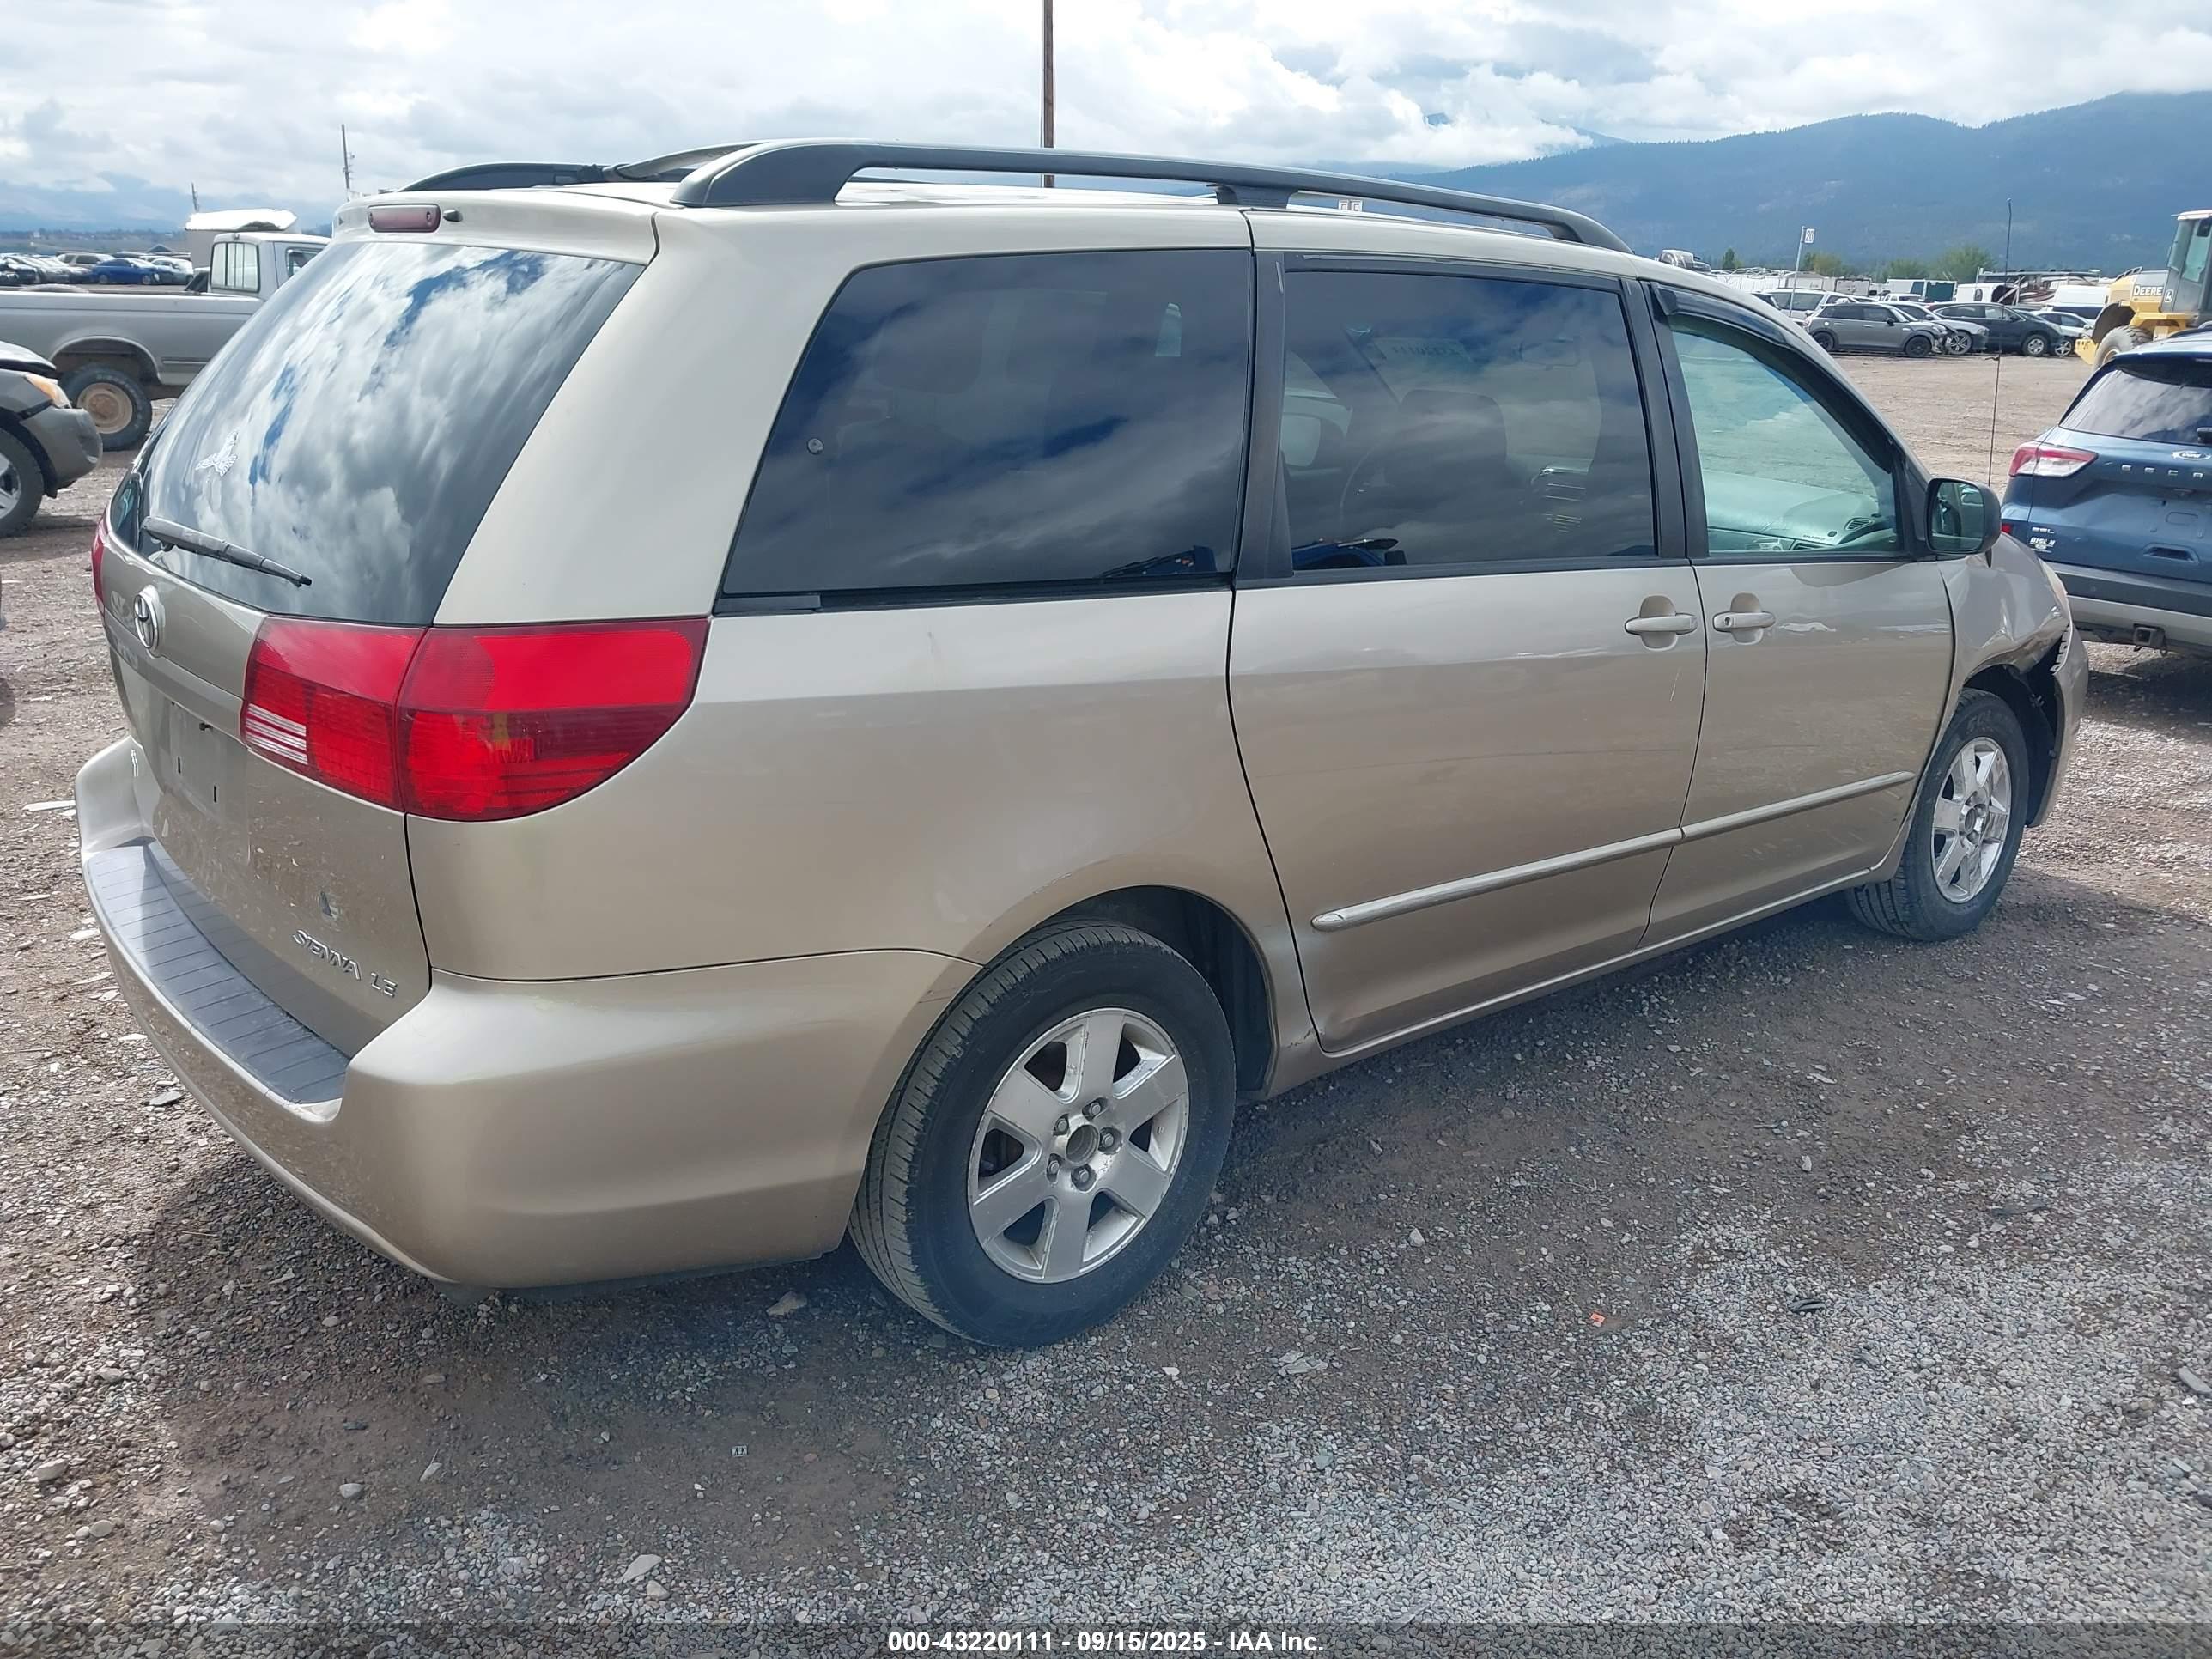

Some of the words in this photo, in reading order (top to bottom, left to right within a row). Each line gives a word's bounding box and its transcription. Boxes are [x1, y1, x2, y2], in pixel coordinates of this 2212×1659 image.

[1805, 229, 1814, 241] 20
[2132, 284, 2165, 297] DEERE
[292, 929, 362, 981] SIENNA
[370, 971, 398, 997] LE
